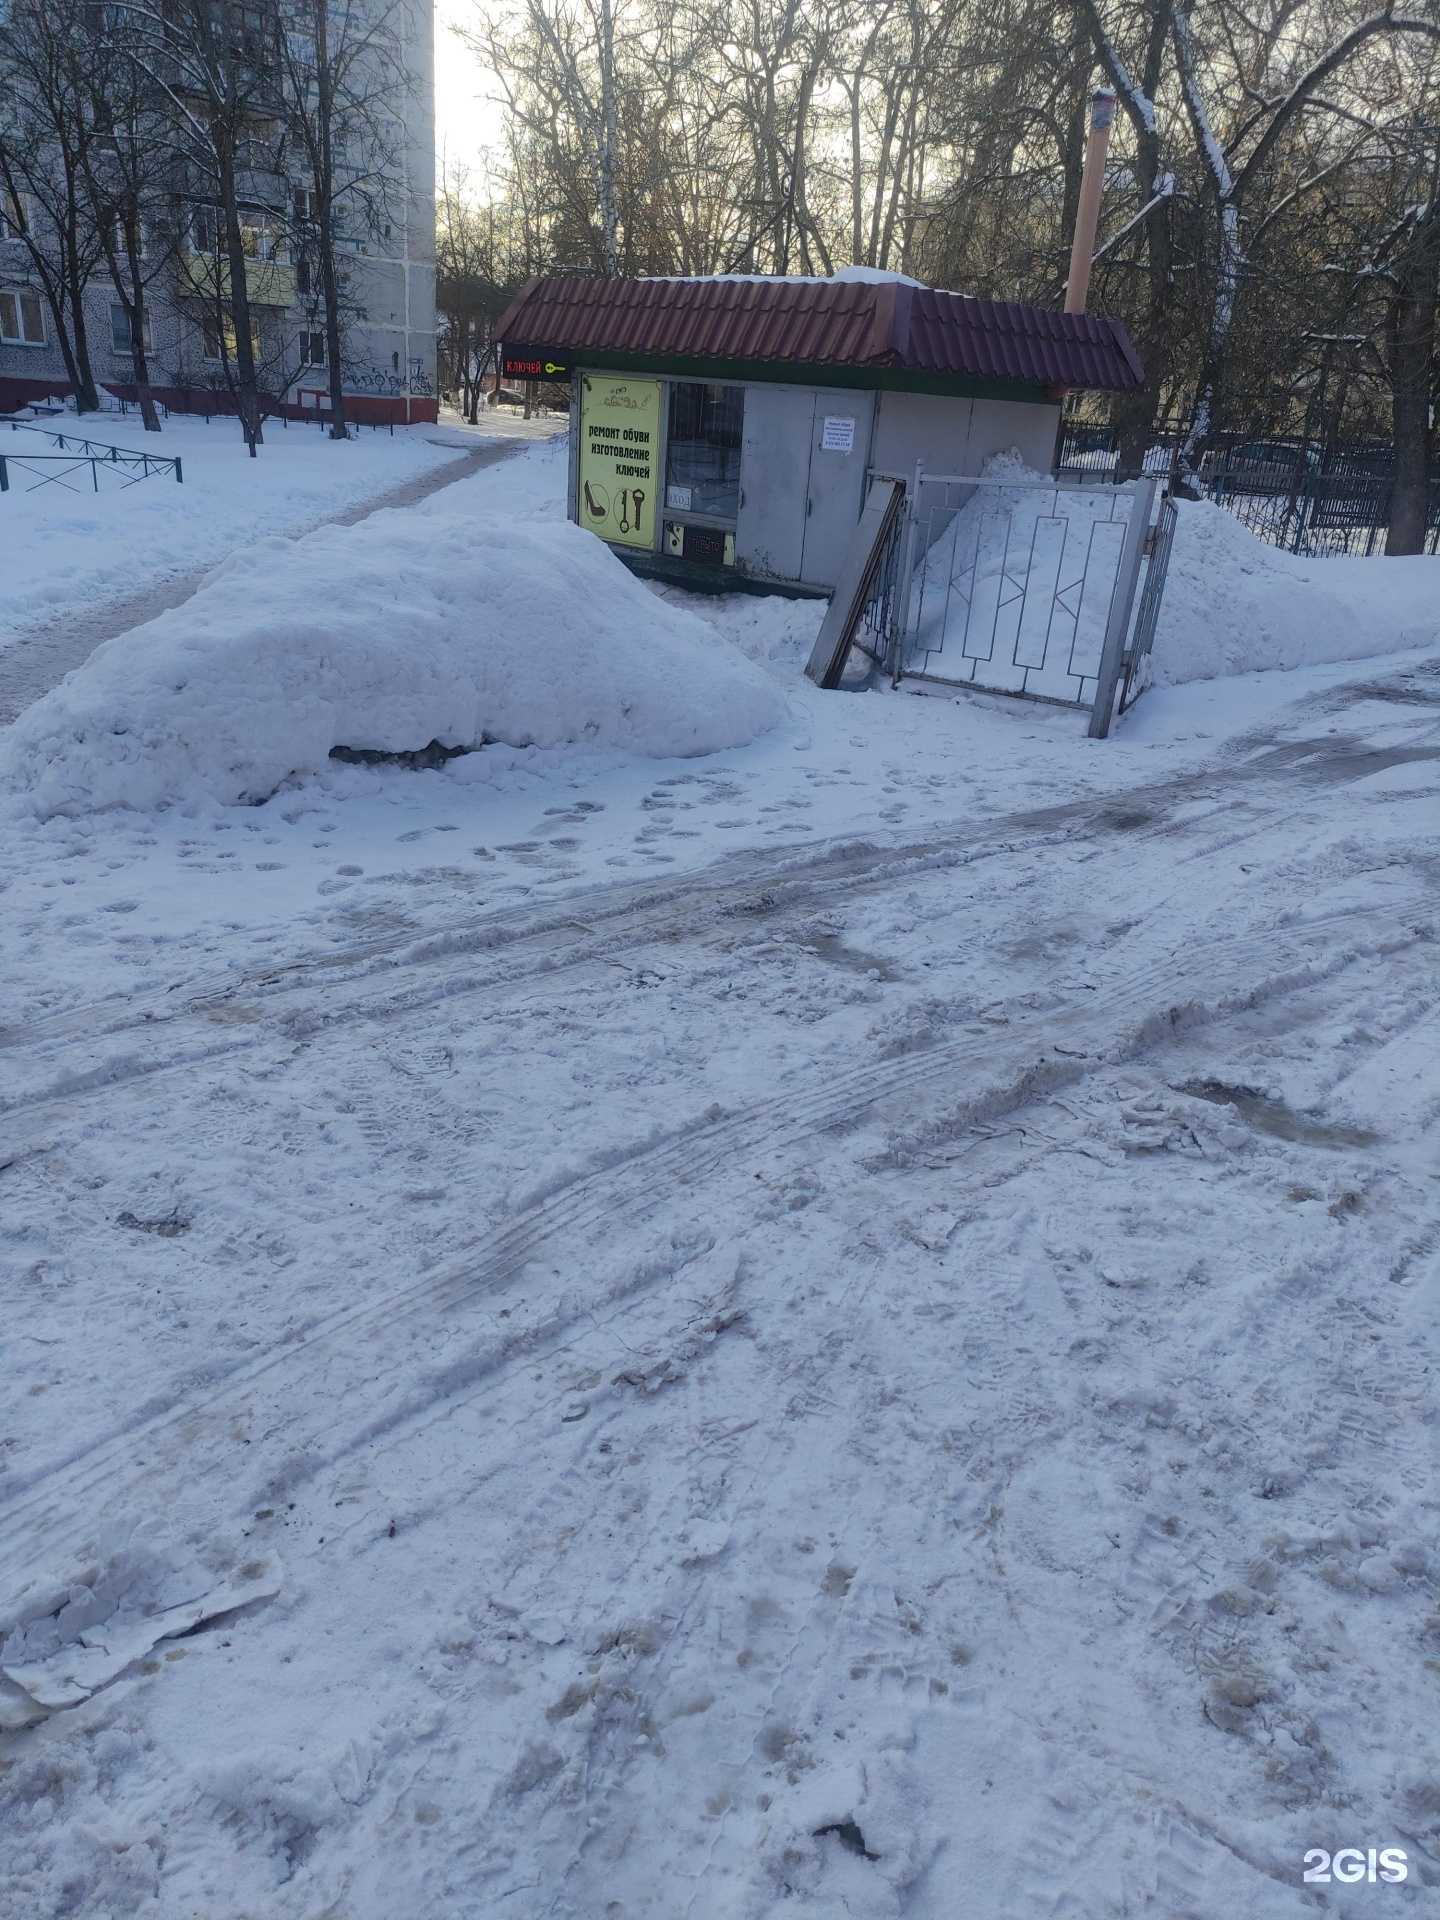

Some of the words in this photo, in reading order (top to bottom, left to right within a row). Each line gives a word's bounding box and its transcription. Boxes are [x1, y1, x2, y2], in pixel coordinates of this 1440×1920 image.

[589, 426, 620, 440] ремонт
[623, 428, 650, 443] обуви
[592, 443, 650, 461] изготовление
[616, 464, 650, 479] ключей
